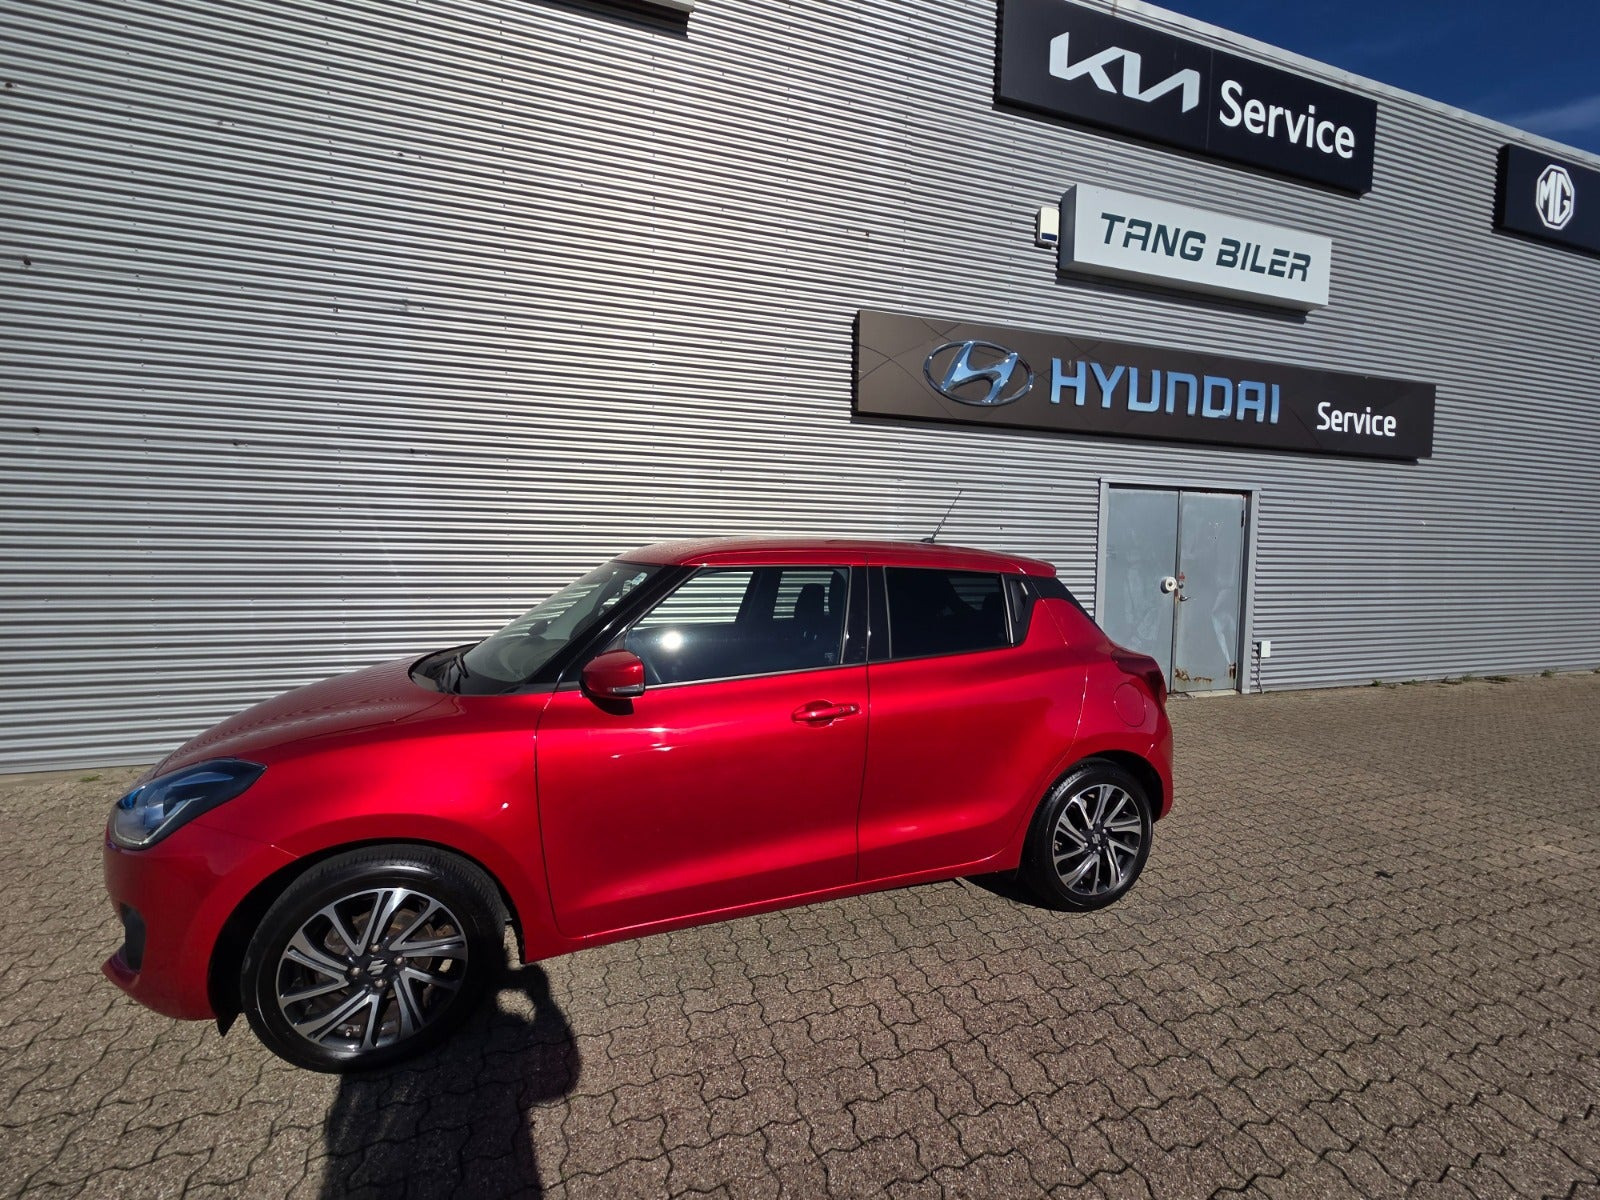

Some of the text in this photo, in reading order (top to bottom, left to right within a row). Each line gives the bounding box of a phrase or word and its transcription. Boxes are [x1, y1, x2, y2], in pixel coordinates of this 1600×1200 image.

[1049, 32, 1356, 159] KIA Service
[1540, 170, 1572, 224] MG
[1100, 212, 1312, 283] TANG BILER
[1050, 357, 1281, 425] HYUNDAI
[1316, 401, 1397, 437] Service
